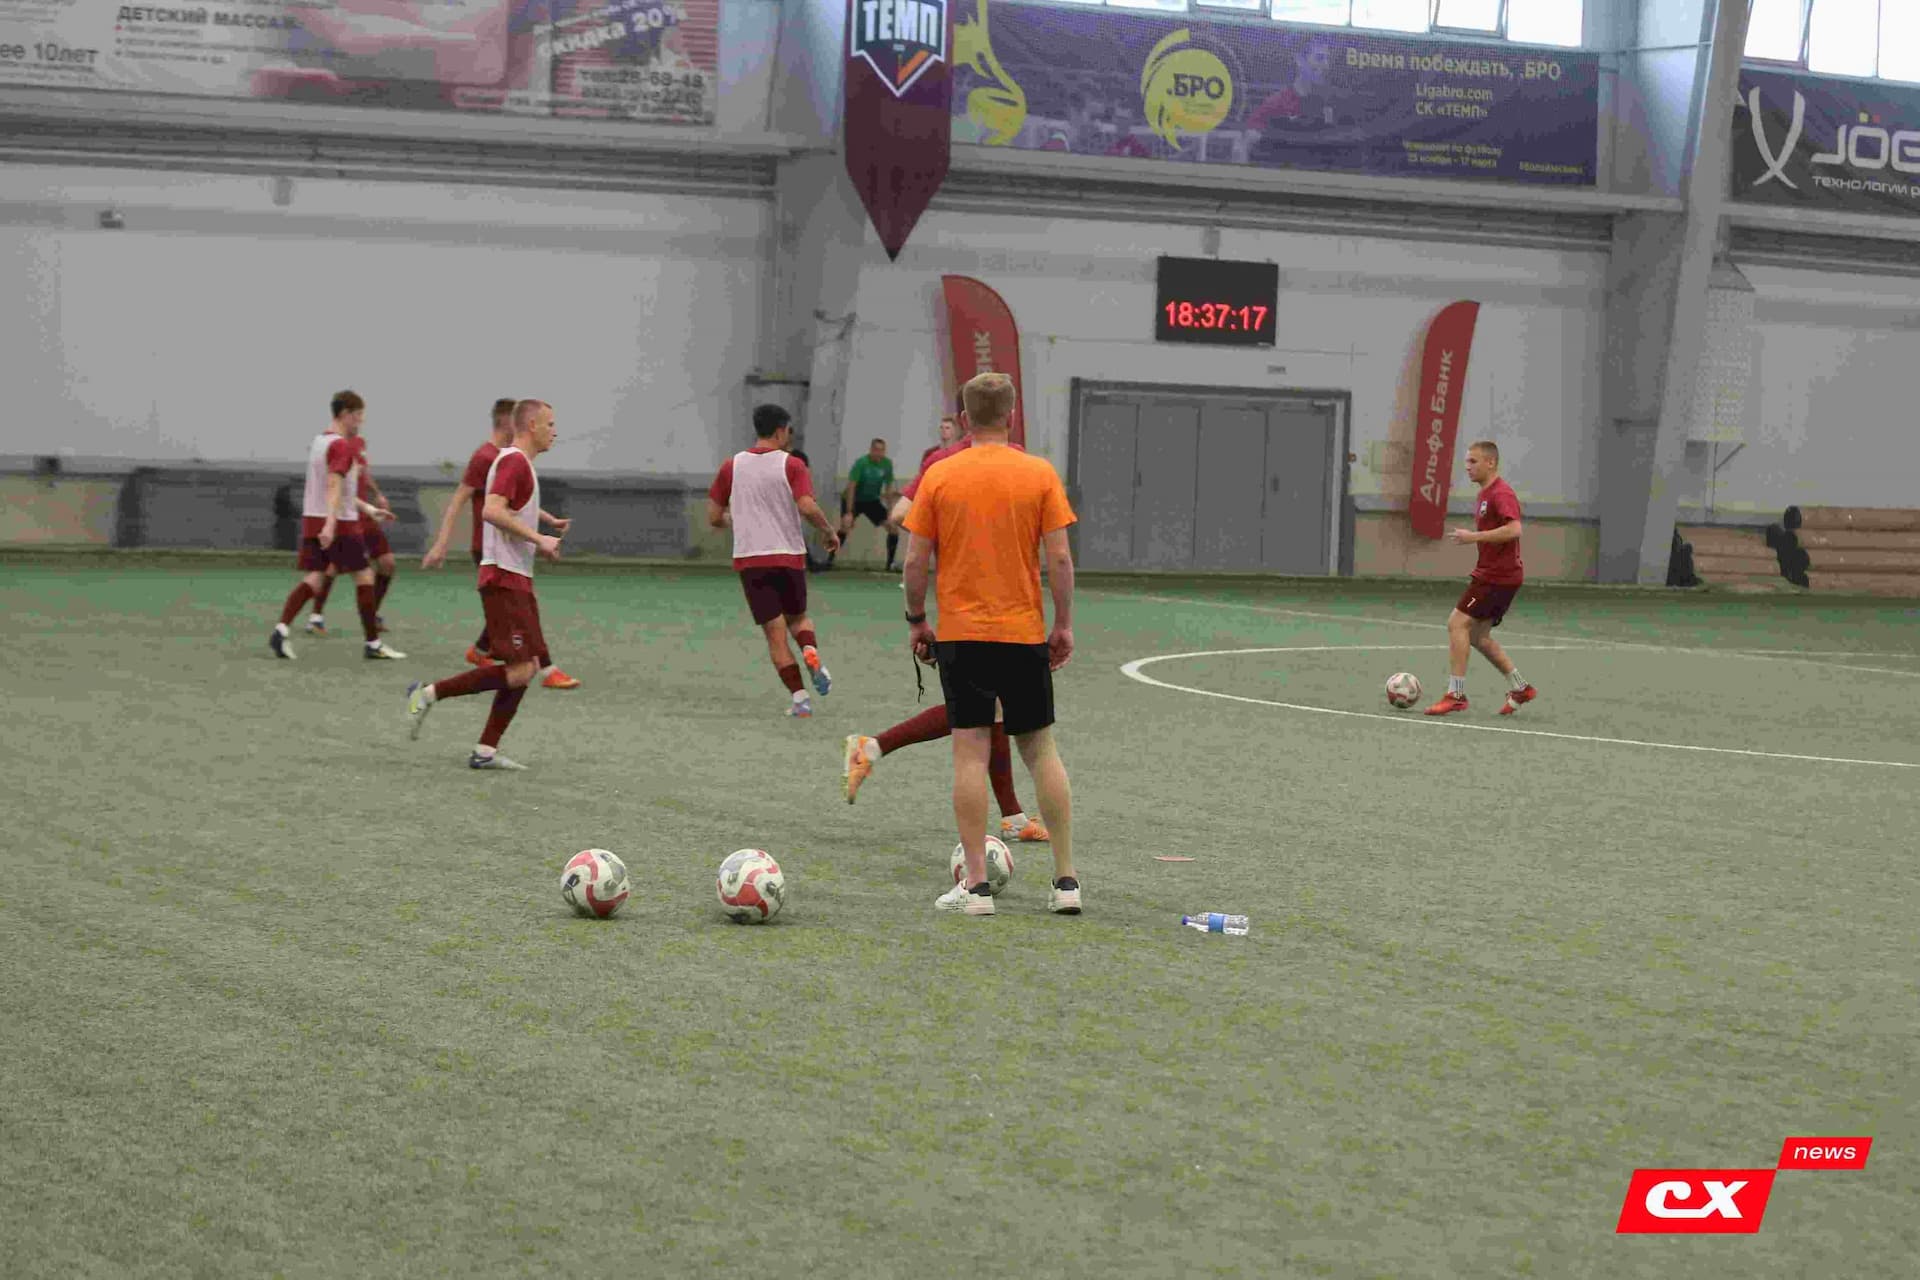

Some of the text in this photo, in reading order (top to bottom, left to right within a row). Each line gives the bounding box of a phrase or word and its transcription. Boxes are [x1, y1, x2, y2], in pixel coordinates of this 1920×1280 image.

[116, 6, 208, 23] ДЕТСКИЙ
[863, 0, 939, 48] ТЕМП
[1346, 47, 1404, 70] Время
[1410, 54, 1514, 79] побеждать,
[1416, 83, 1493, 101] Ligabro.com
[1416, 104, 1433, 117] СК
[1165, 301, 1268, 331] 18:37:17
[1419, 349, 1453, 506] Альфа Банк
